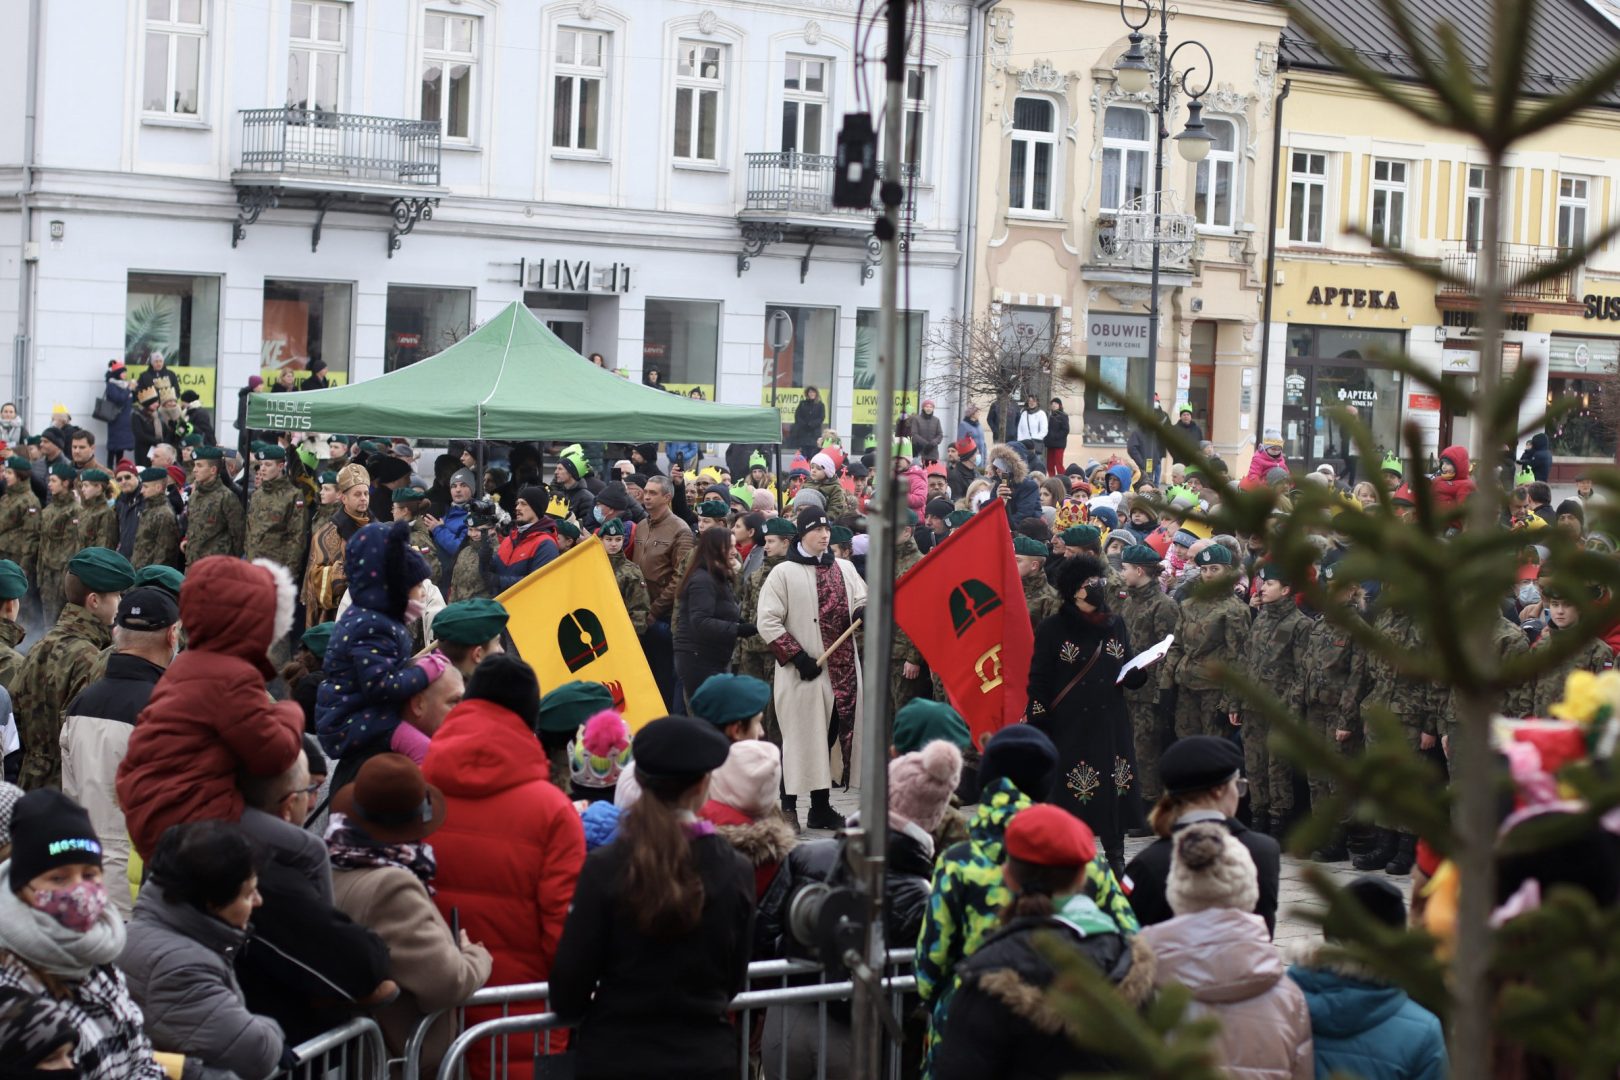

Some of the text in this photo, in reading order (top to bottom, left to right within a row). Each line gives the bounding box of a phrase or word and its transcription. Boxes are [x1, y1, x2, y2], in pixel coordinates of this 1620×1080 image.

[1306, 286, 1400, 309] APTEKA
[1584, 294, 1620, 321] SUS
[1091, 323, 1147, 338] OBUWIE
[1346, 390, 1378, 400] APTEKA
[266, 399, 312, 414] MOBILE
[266, 413, 312, 429] TENTS
